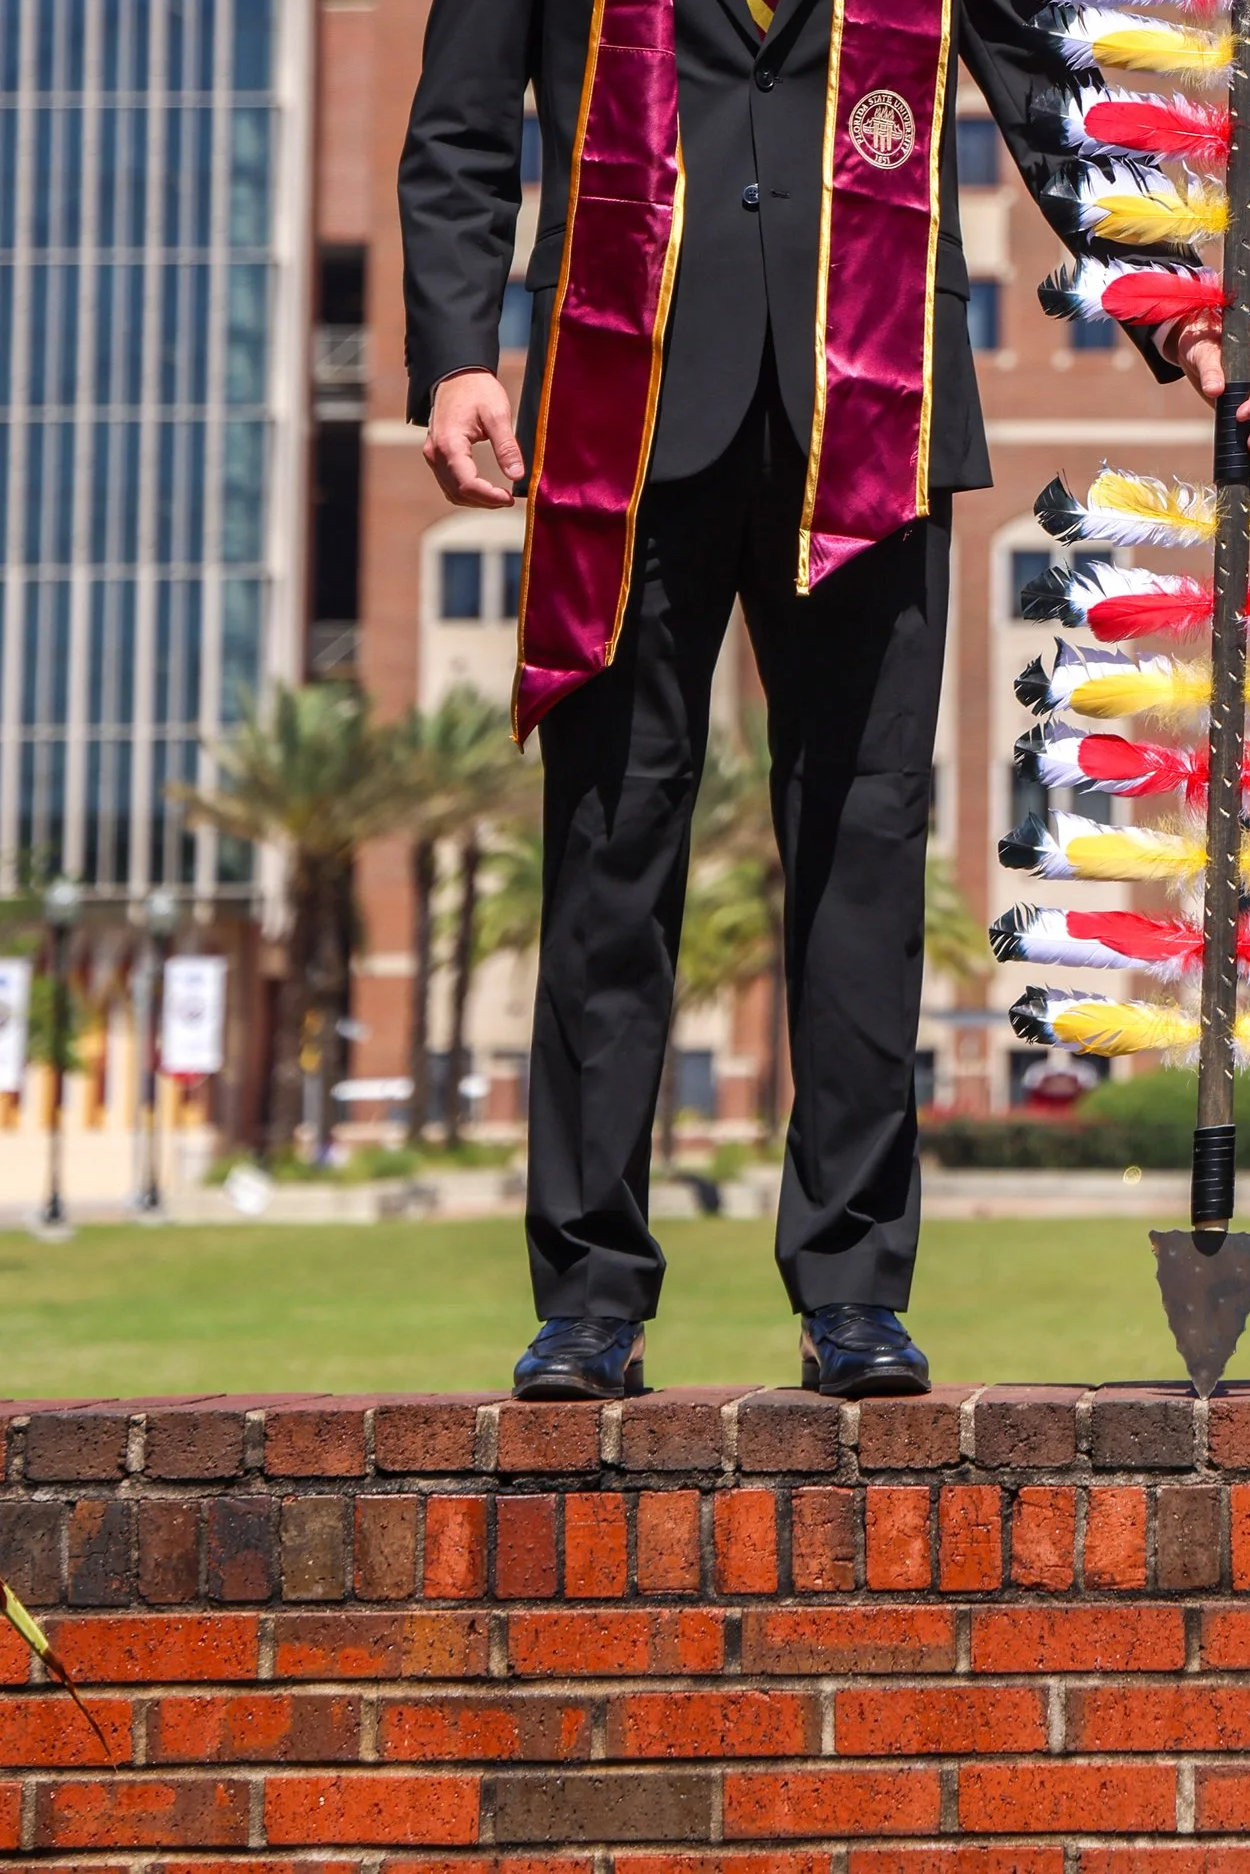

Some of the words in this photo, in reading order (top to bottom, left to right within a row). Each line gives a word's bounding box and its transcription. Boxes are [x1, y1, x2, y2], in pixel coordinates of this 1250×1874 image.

[853, 103, 867, 145] FLORIDA
[868, 94, 893, 105] STATE
[894, 99, 913, 155] UNIVERSITY
[874, 155, 891, 165] 1851
